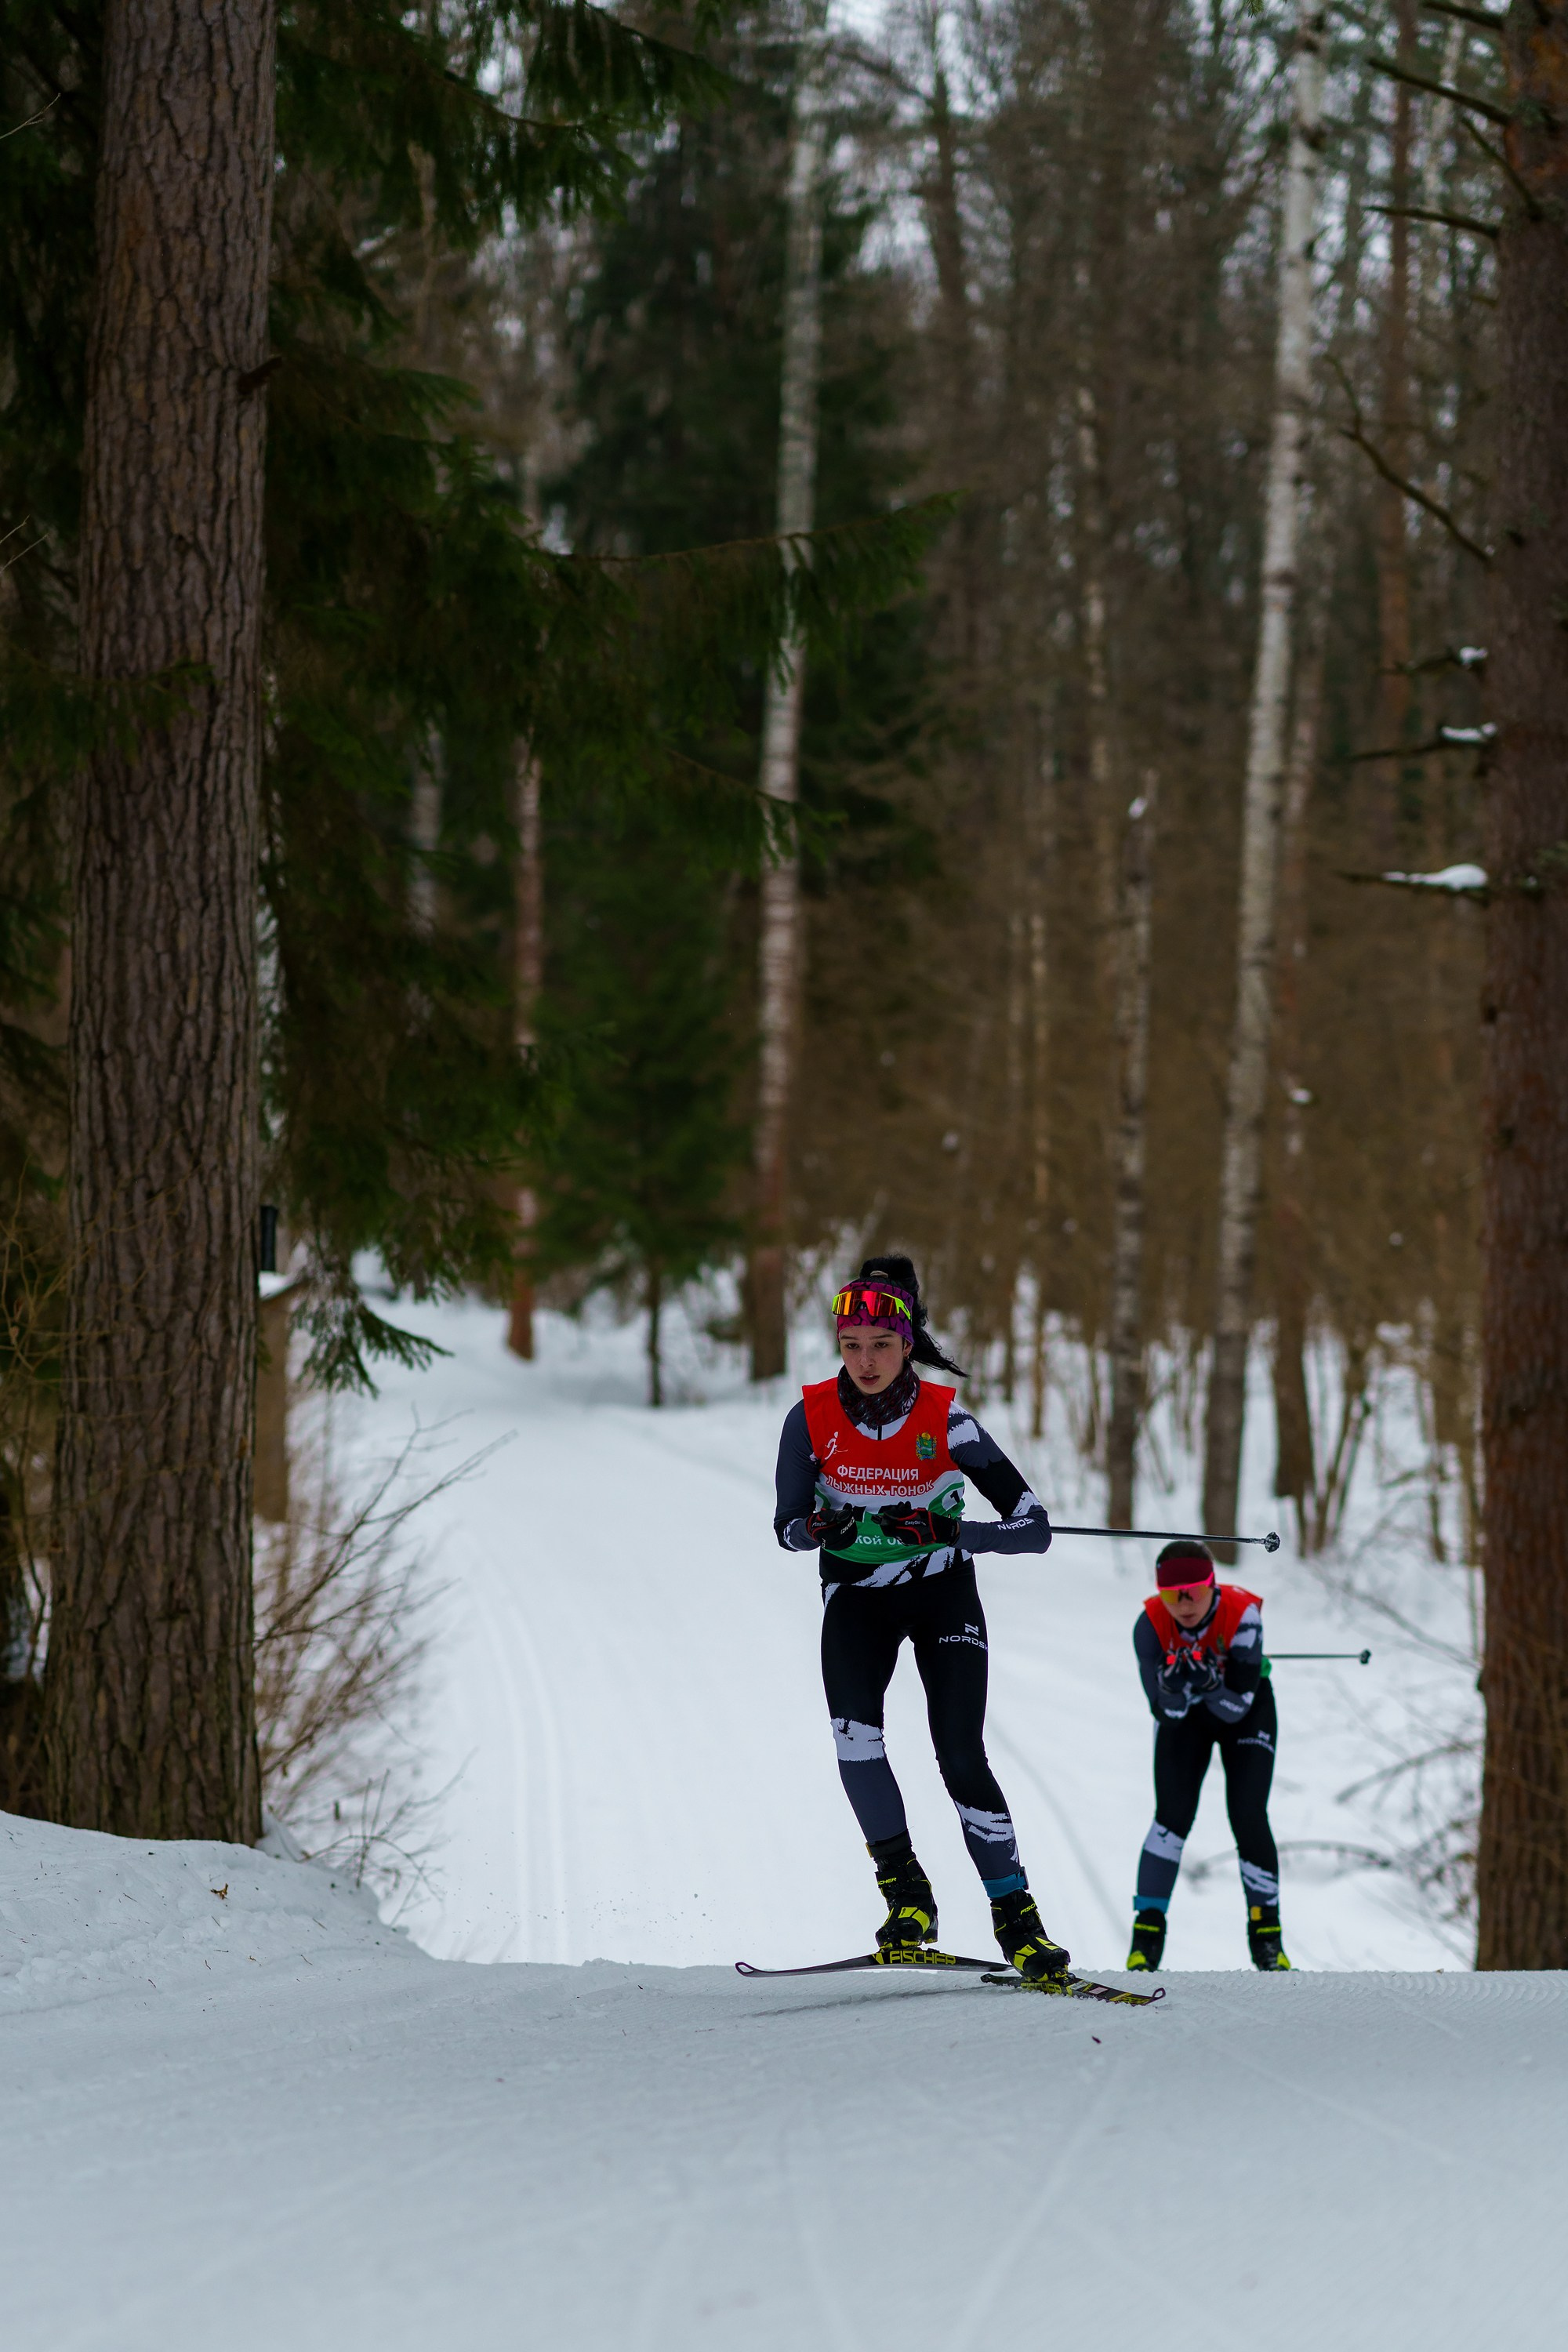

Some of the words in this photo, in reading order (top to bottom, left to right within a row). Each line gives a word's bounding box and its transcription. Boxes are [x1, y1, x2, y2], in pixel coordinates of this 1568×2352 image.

[837, 1465, 919, 1483] ФЕДЕРАЦИЯ
[826, 1475, 887, 1496] ЛЫЖНЫХ
[891, 1480, 934, 1497] ГОНОК
[889, 1950, 956, 1965] FISCHER
